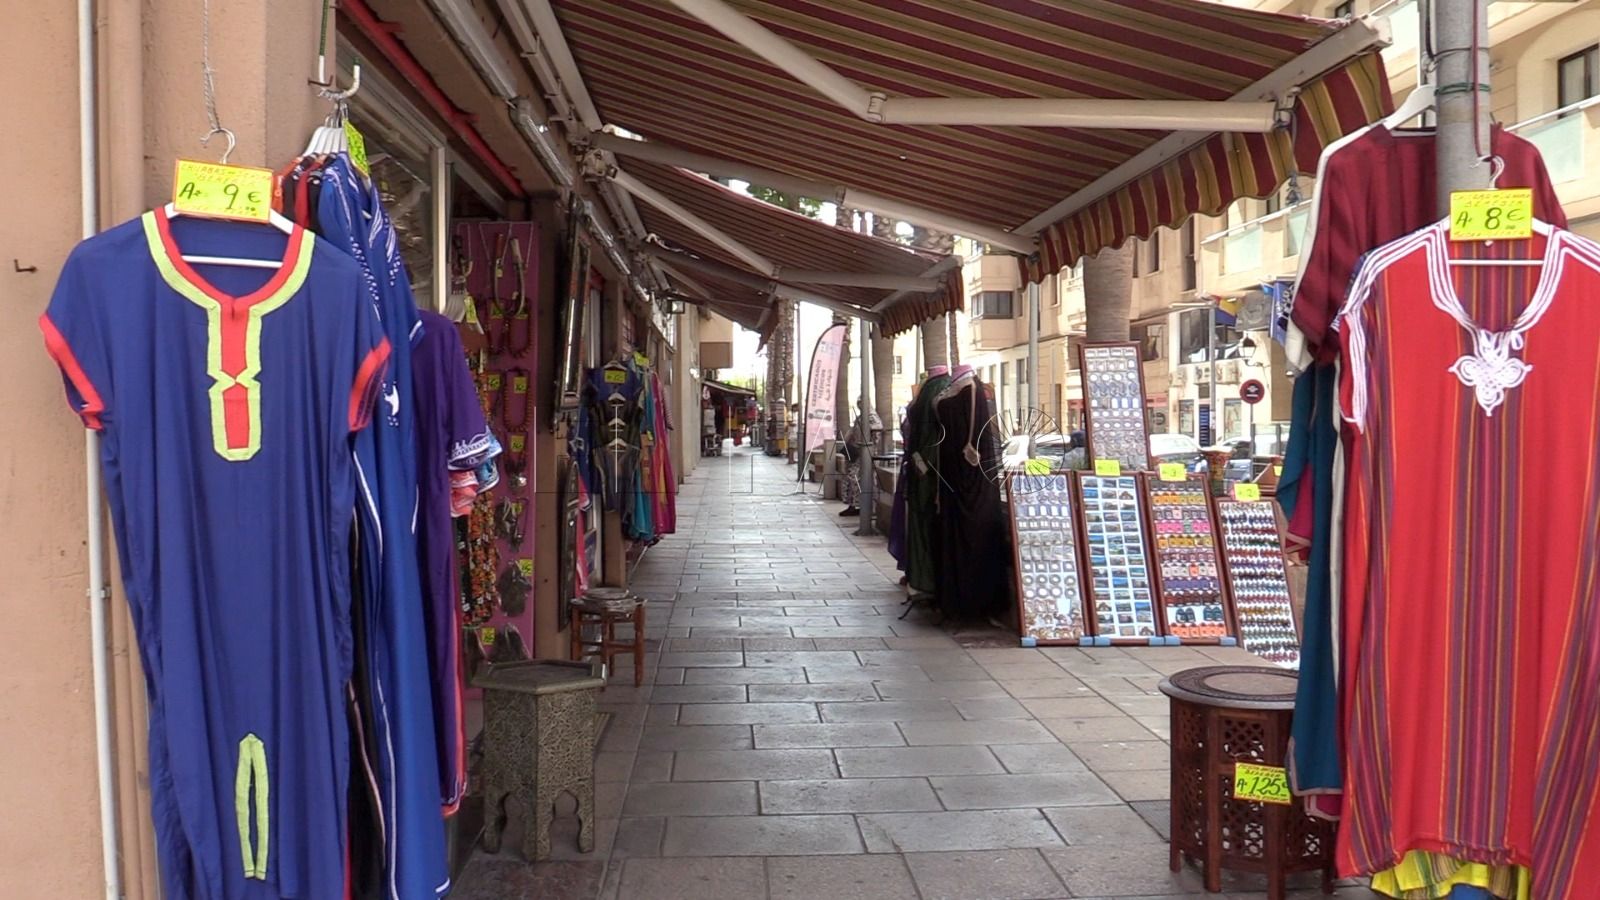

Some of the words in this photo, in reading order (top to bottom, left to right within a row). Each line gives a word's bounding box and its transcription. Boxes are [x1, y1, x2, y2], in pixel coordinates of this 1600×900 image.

[223, 183, 239, 210] 9
[247, 191, 261, 203] €
[1484, 206, 1502, 230] 8
[1506, 208, 1526, 221] €
